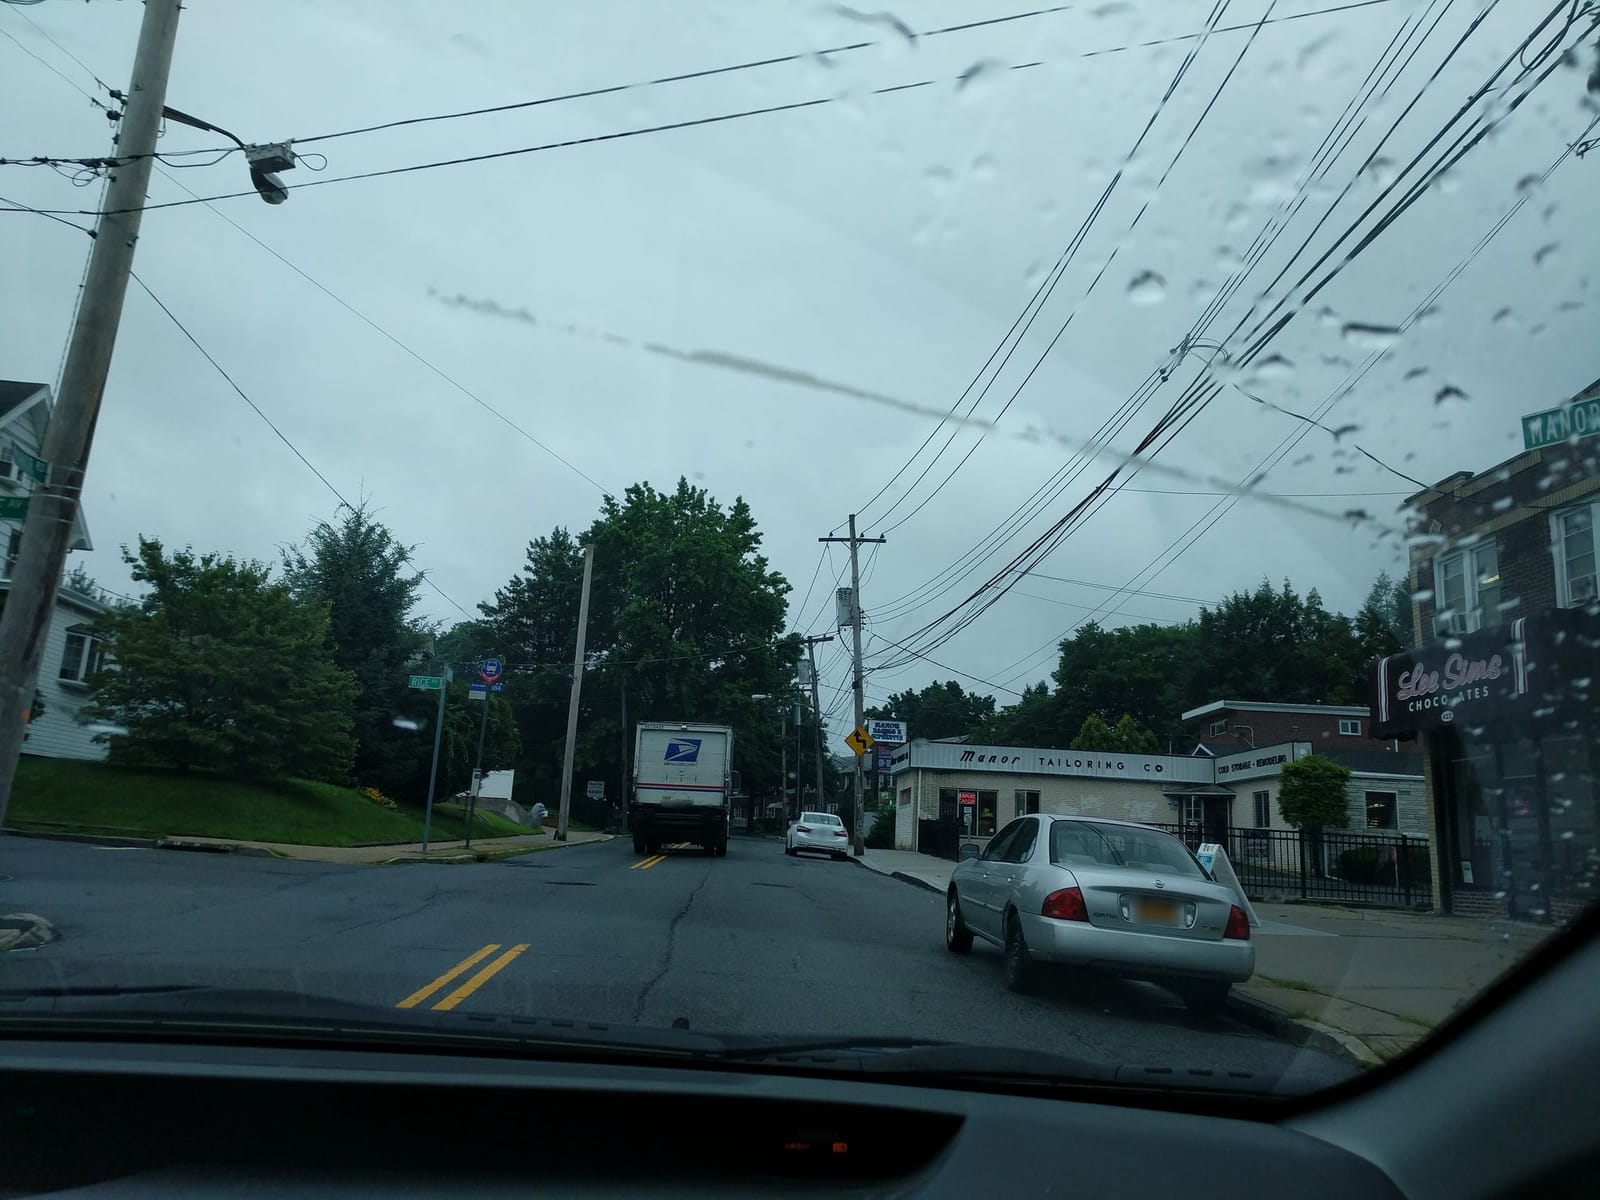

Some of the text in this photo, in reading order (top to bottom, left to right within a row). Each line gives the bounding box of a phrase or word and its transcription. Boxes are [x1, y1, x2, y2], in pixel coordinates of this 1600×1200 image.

[411, 678, 429, 687] RICE
[1396, 652, 1503, 701] Lee Sims
[1408, 686, 1489, 712] CHOCOATES
[959, 749, 1164, 774] Manor TAILORING CO
[1231, 760, 1252, 773] STORAGE
